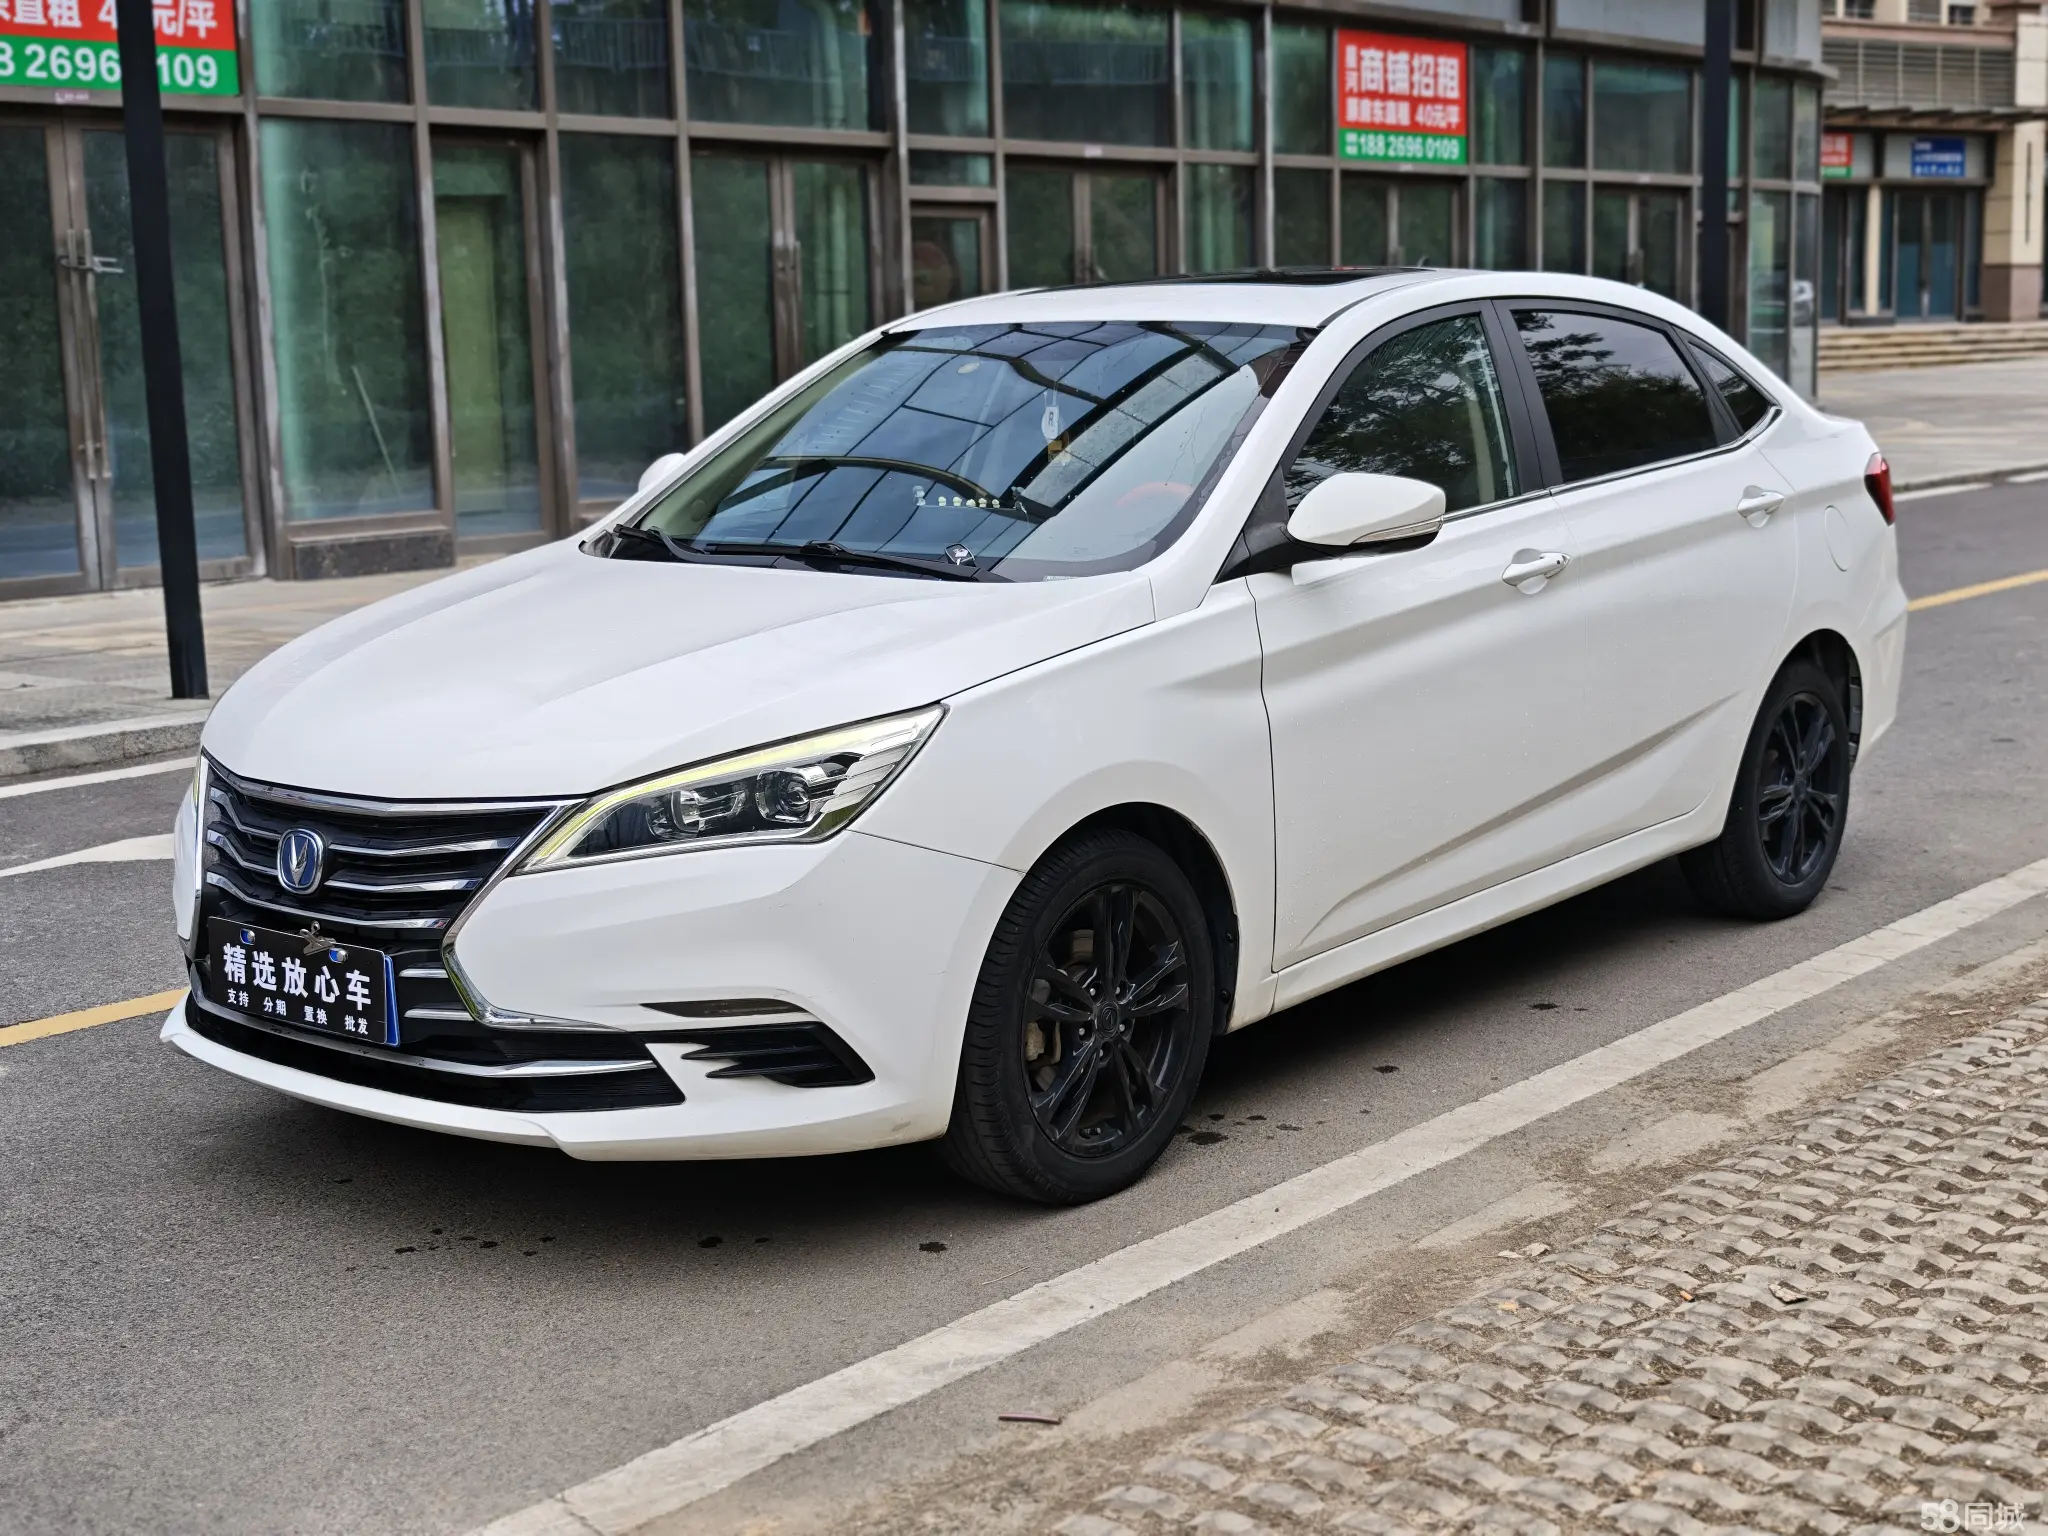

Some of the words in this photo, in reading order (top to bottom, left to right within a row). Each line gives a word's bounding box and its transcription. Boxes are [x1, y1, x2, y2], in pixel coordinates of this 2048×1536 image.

[0, 0, 83, 28] 直租
[97, 0, 218, 39] 4元/平
[24, 43, 122, 83] 2696
[155, 52, 218, 88] 109
[1359, 47, 1460, 99] 商铺招租
[1360, 132, 1386, 156] 188
[1387, 134, 1424, 158] 2696
[1425, 137, 1460, 160] 0109
[223, 942, 371, 1011] 精选放心车
[227, 987, 249, 1008] 支持
[263, 996, 287, 1016] 分期
[304, 1005, 328, 1026] 置换
[344, 1015, 369, 1036] 批发
